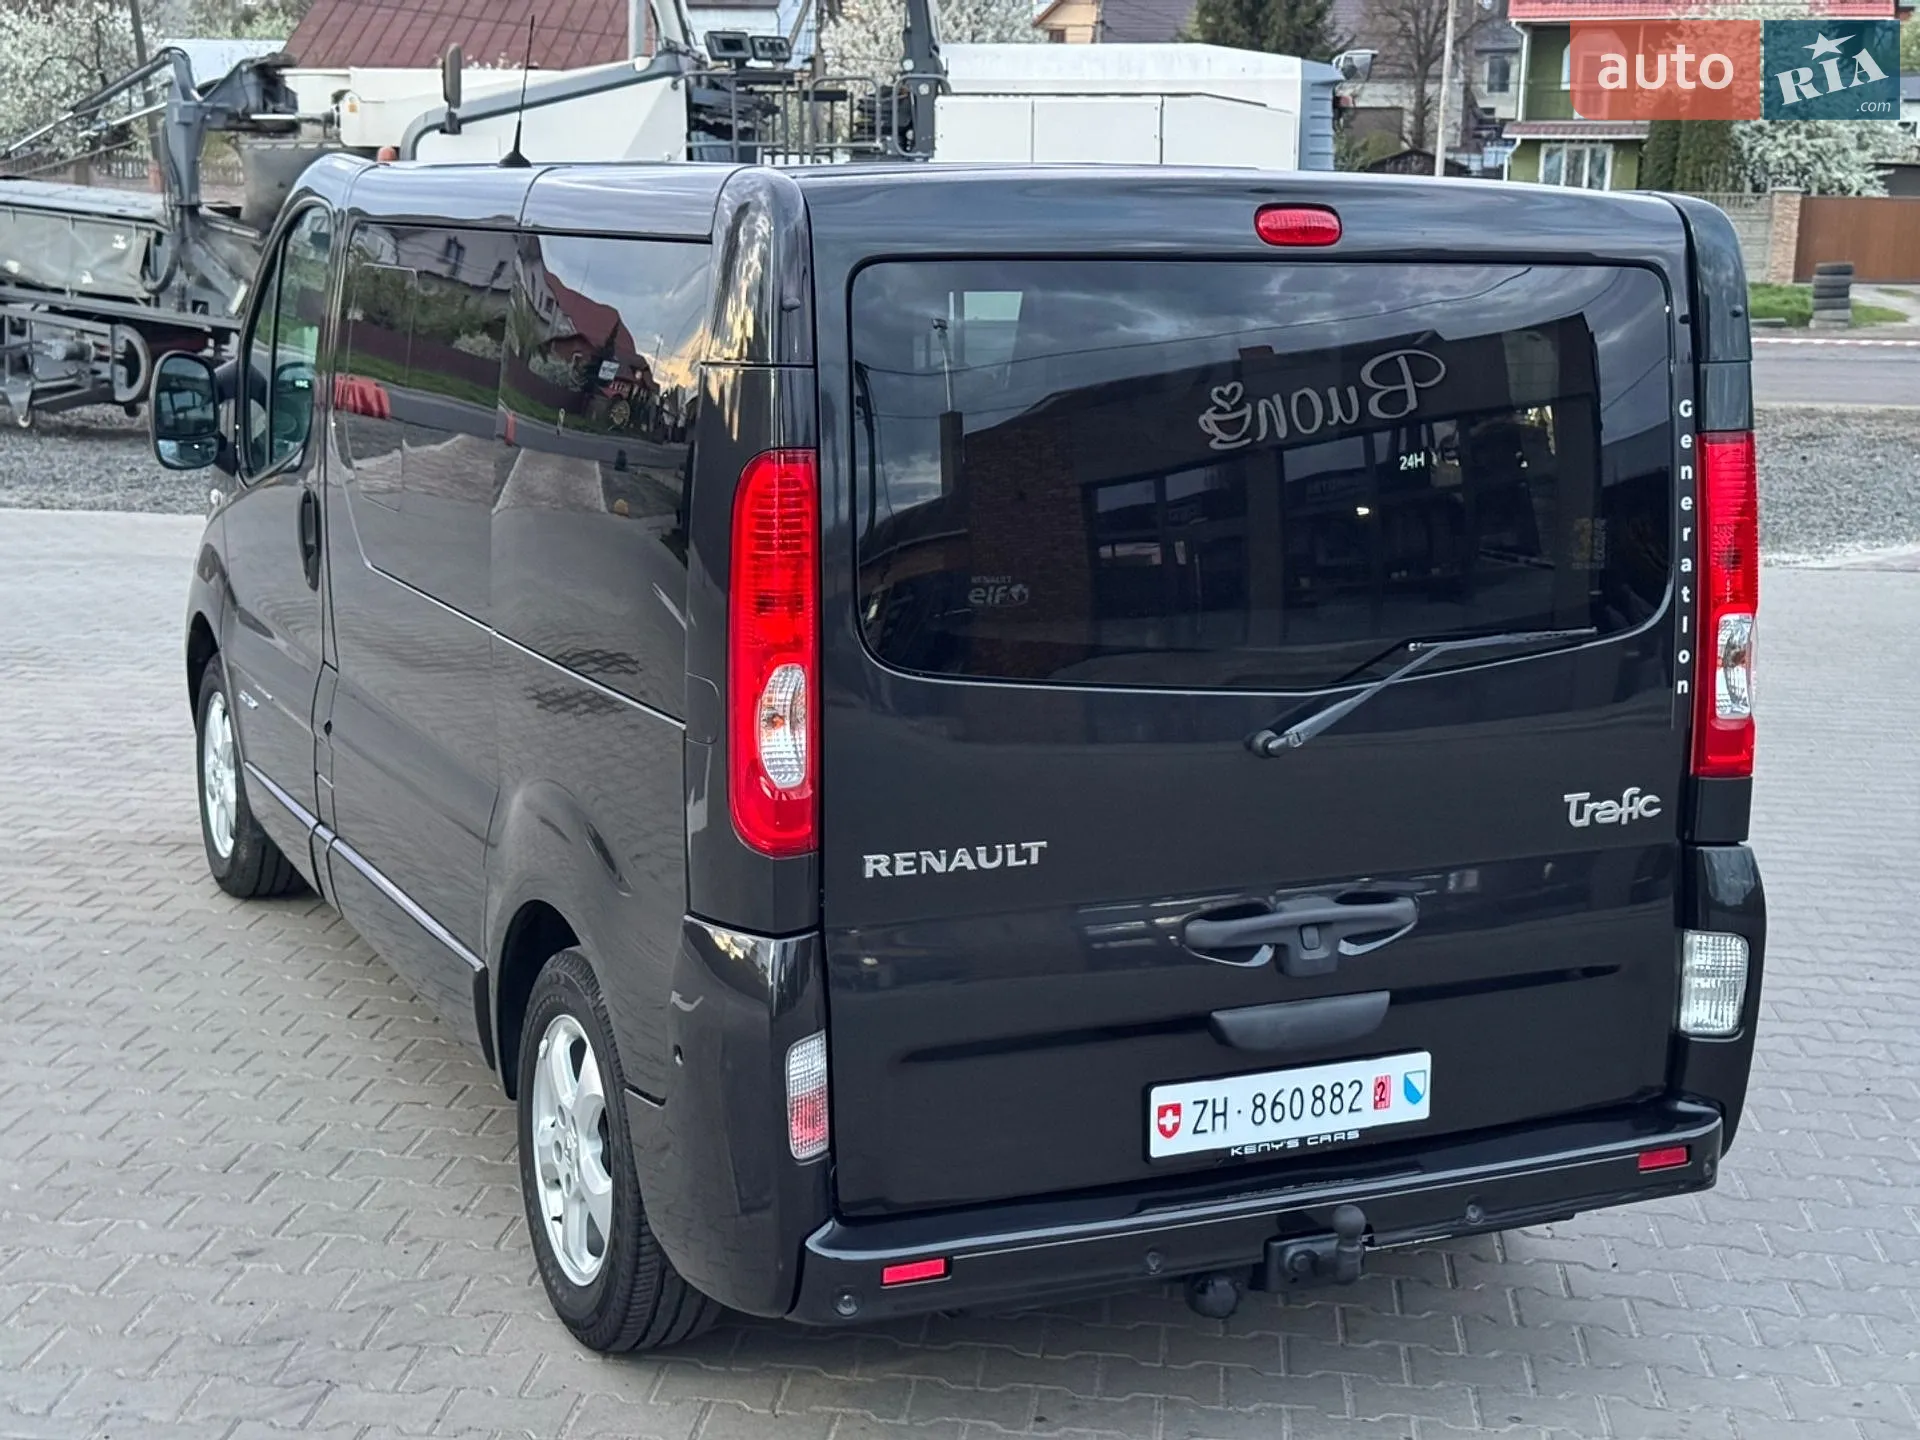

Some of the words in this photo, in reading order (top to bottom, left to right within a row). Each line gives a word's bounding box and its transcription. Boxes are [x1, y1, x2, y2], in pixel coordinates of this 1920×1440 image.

[1563, 786, 1662, 828] Trafic
[863, 840, 1048, 879] RENAULT
[1250, 1079, 1364, 1126] 860882
[1306, 1129, 1361, 1146] CARS
